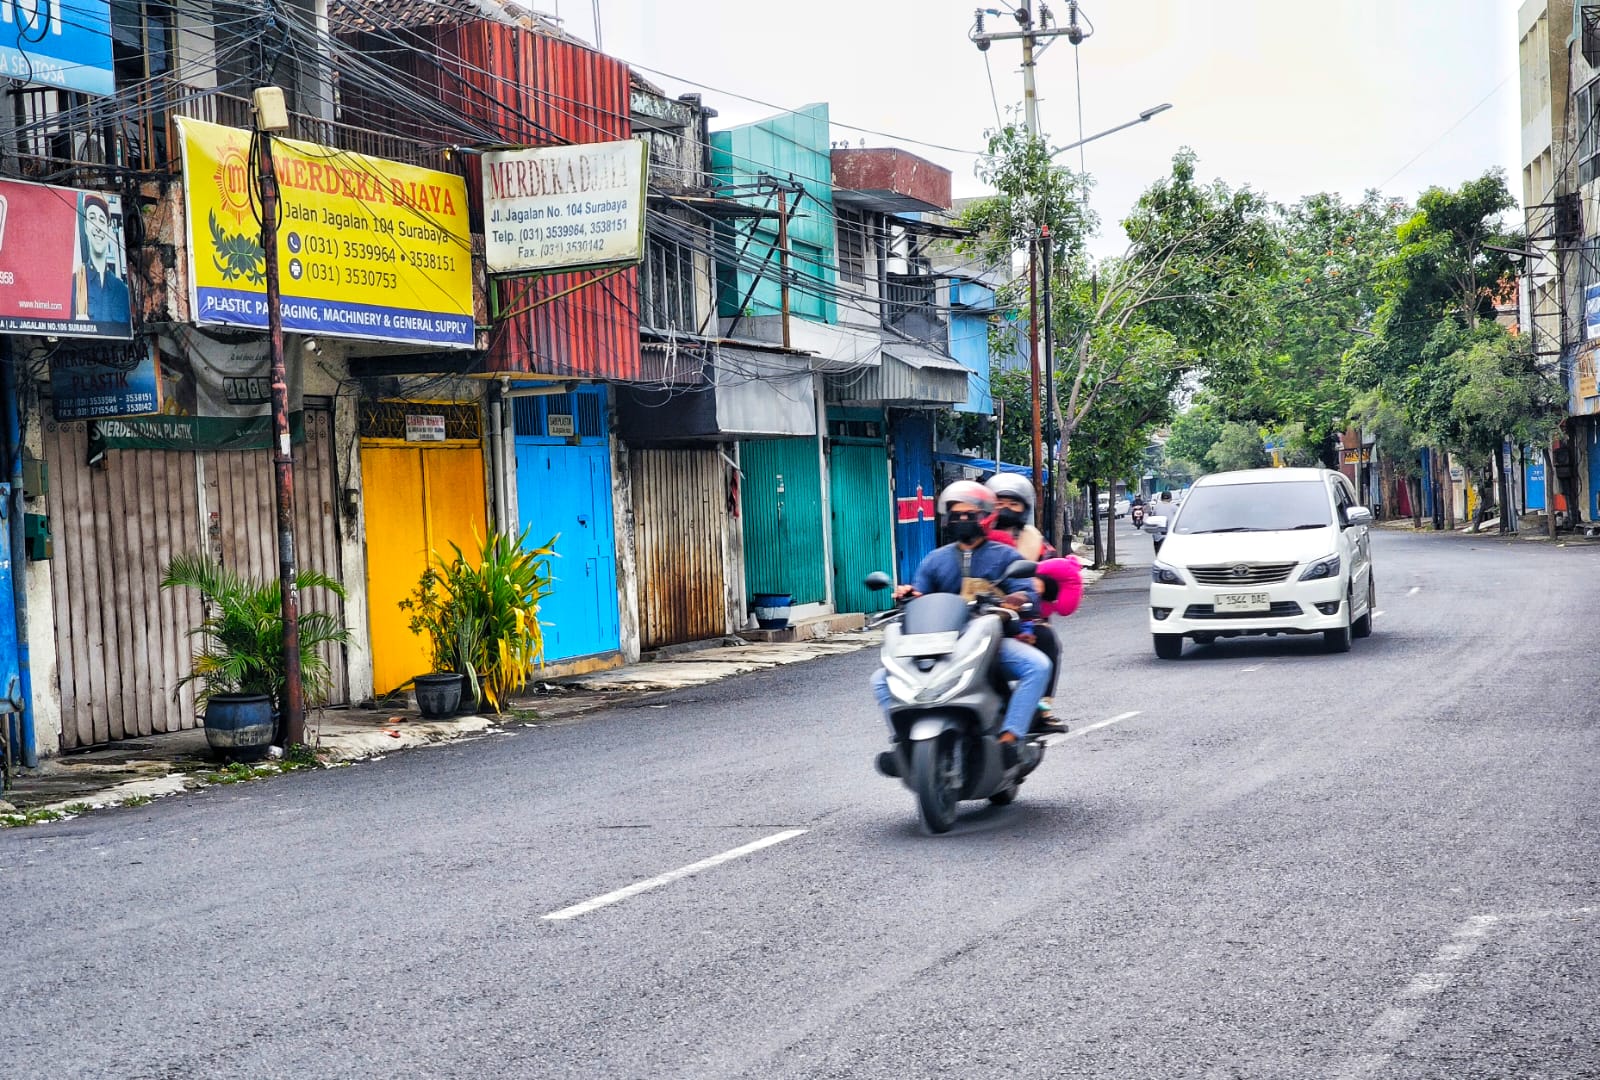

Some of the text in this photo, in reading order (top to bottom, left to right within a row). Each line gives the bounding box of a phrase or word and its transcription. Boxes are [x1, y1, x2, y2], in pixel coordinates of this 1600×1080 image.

[11, 55, 66, 84] SENTOSA
[272, 155, 457, 216] MERDEKA DJAYA
[489, 157, 577, 200] MERDEKA
[285, 201, 449, 246] Jalan Jagalan 104 Surabaya
[490, 198, 628, 225] Jl. Jagalan No. 104 Surabaya
[492, 230, 517, 245] Telp.
[519, 227, 544, 244] (031)
[589, 218, 628, 236] 3538151
[304, 234, 456, 273] (031) 3539964 3538151
[518, 246, 538, 259] Fax.
[305, 262, 398, 290] (031) 3530753
[206, 295, 253, 314] PLASTIC
[323, 308, 382, 326] MACHINERY
[383, 315, 391, 328] &
[393, 315, 434, 332] GENERAL
[435, 320, 467, 335] SUPPLY
[72, 372, 129, 392] PLASTIK
